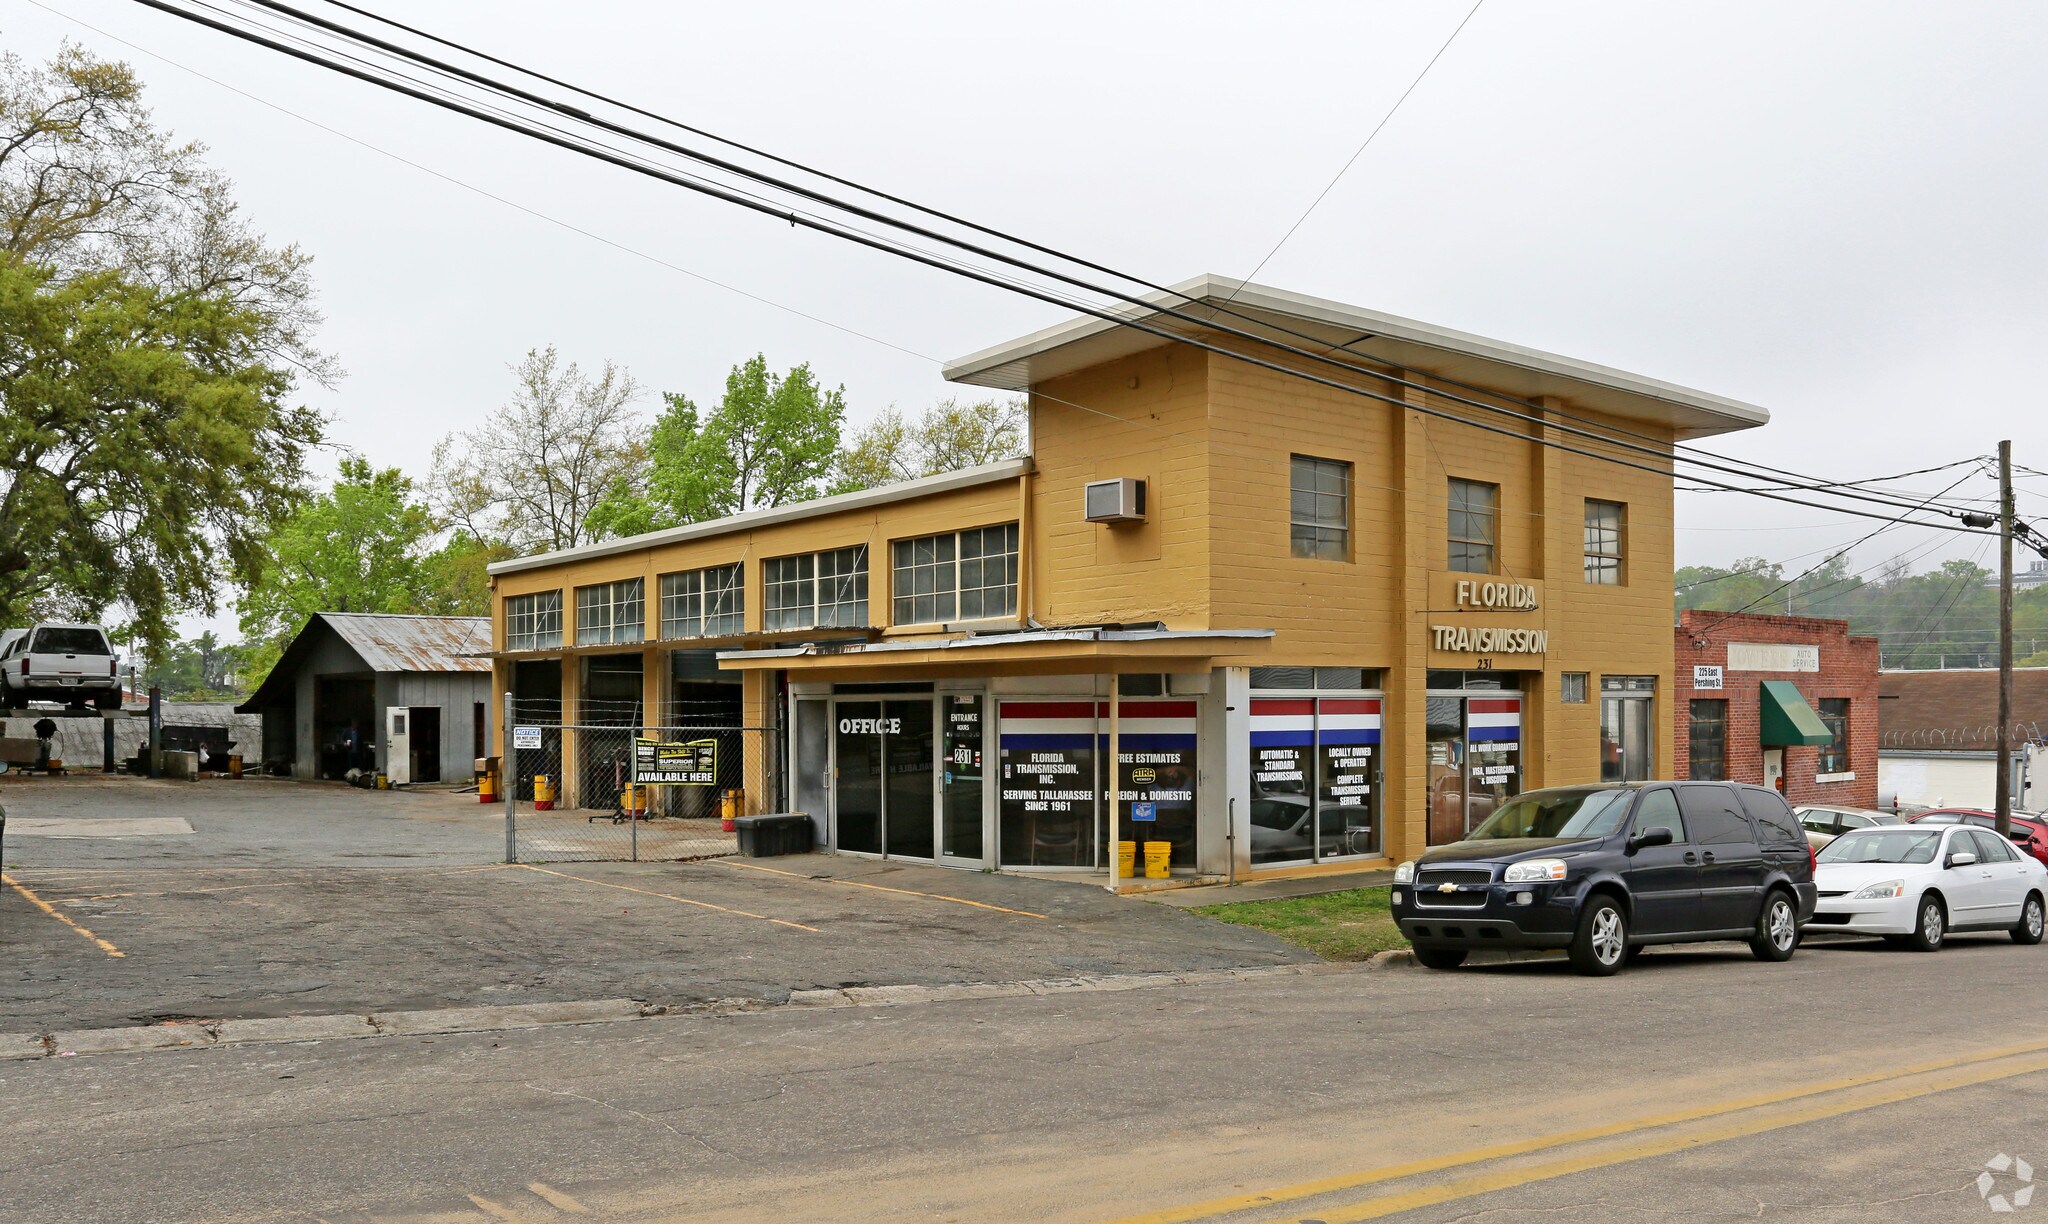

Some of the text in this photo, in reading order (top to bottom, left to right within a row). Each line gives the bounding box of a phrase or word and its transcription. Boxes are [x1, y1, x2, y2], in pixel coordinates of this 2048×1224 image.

[1456, 580, 1537, 609] FLORIDA
[1432, 625, 1549, 654] TRANSMISSION
[1797, 650, 1811, 658] AUTO
[1477, 658, 1493, 670] 231
[1792, 658, 1816, 667] SERVICE
[1698, 667, 1718, 676] 225 East
[1694, 677, 1715, 688] Pershing
[950, 713, 978, 722] ENTRANCE
[839, 718, 901, 735] OFFICE
[1328, 747, 1371, 757] LOCALLY OWNED
[1469, 742, 1518, 752] ALL WORK GUARANTEED
[955, 750, 970, 763] 231
[1031, 753, 1064, 763] FLORIDA
[1136, 753, 1181, 764] ESTIMATES
[1260, 749, 1300, 760] AUTOMATIC &
[1264, 760, 1295, 770] STANDARD
[1333, 758, 1367, 768] & OPERATED
[1016, 764, 1079, 775] TRANSMISSION,
[1134, 769, 1154, 777] ATRA
[637, 772, 713, 782] AVAILABLE HERE
[1039, 774, 1056, 784] INC.
[1257, 771, 1303, 782] TRANSMISSIONS
[1337, 775, 1364, 784] COMPLETE
[1481, 775, 1508, 785] & DISCOVER
[1003, 790, 1093, 800] SERVING TALLAHASSEE
[1104, 790, 1192, 801] FEIGN & DOMESTIC
[1331, 785, 1370, 796] TRANSMISSION
[1025, 801, 1071, 811] SINCE 1961
[1340, 796, 1361, 806] SERVICE
